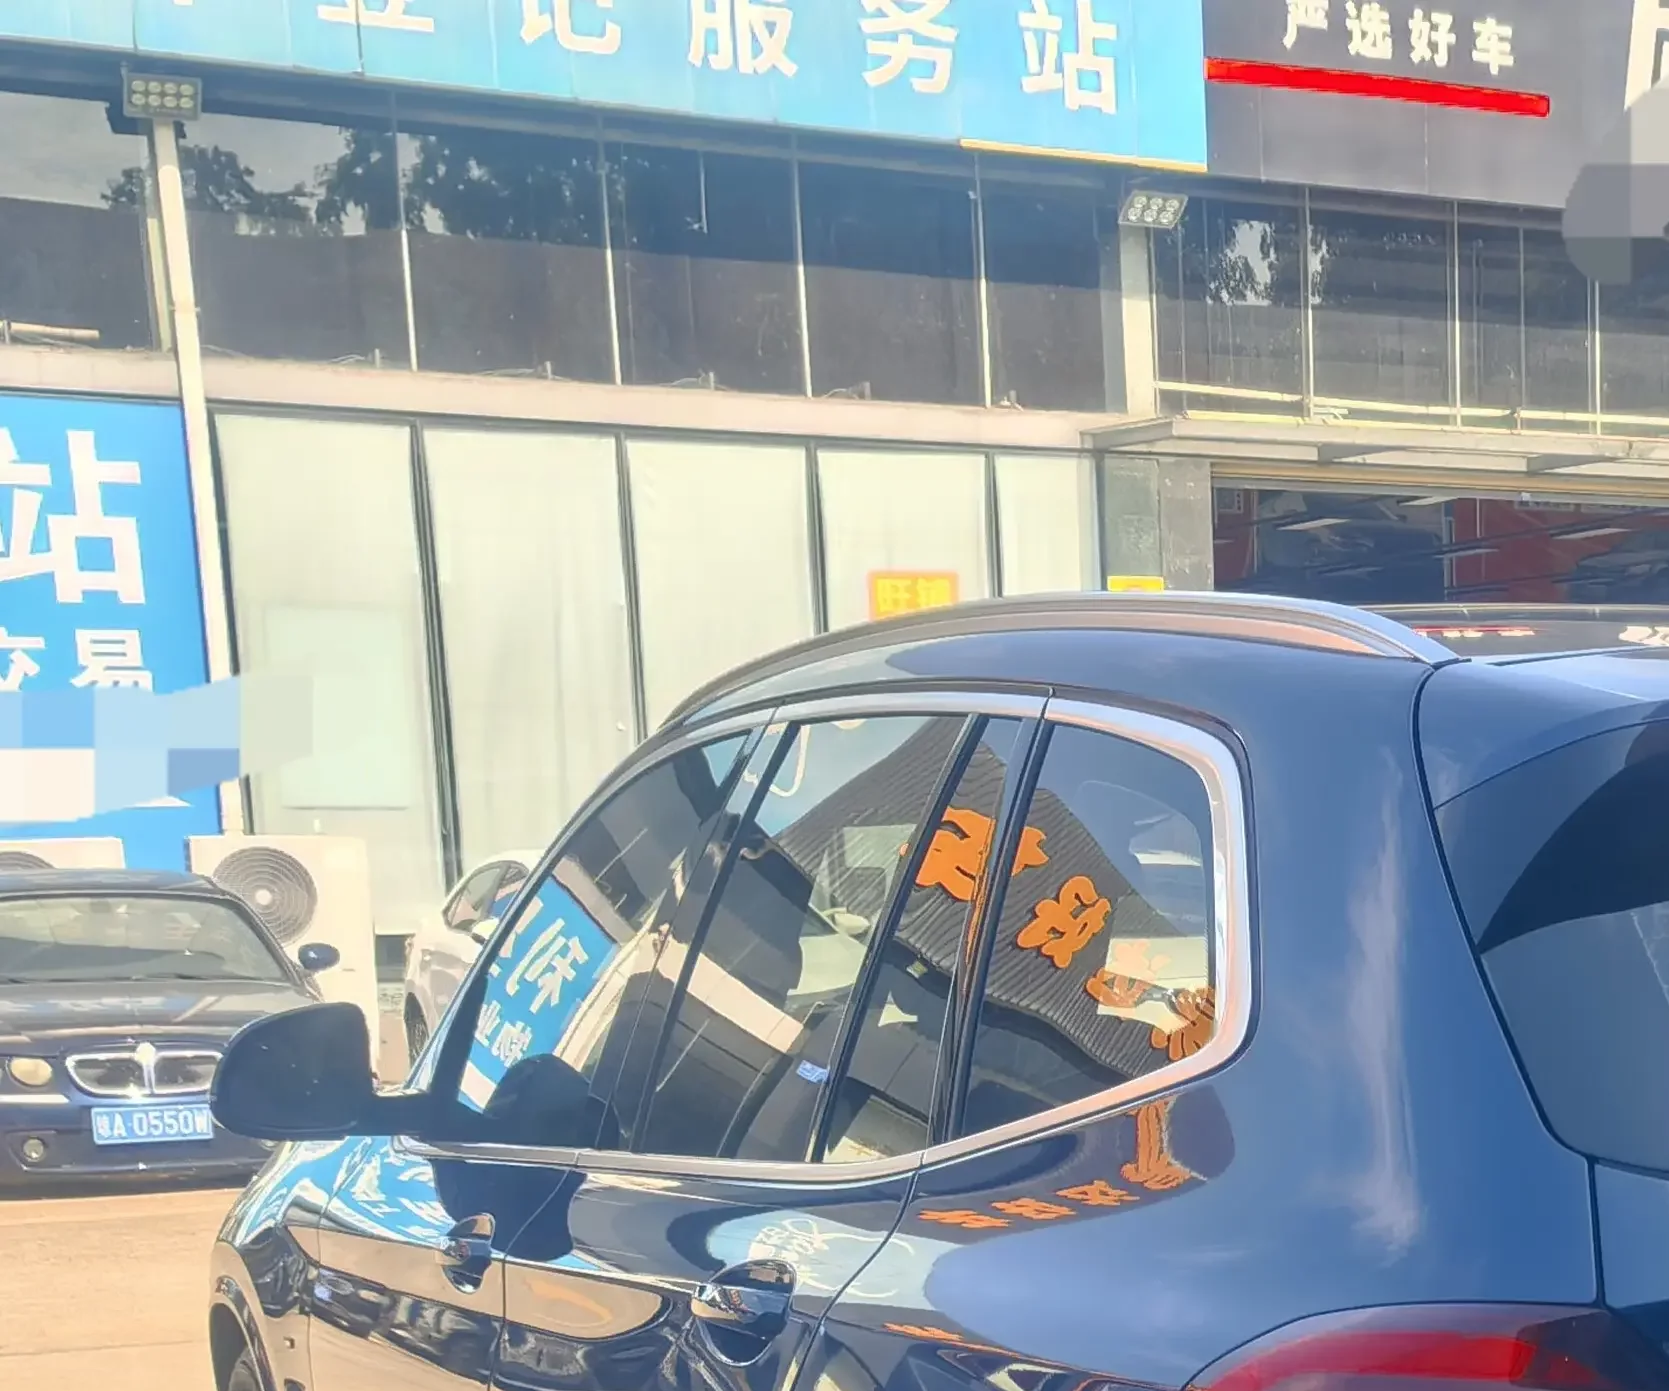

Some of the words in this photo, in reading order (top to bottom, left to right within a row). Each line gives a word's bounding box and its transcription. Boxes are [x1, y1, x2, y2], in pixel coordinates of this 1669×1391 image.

[1282, 0, 1514, 75] 严选好车
[0, 427, 146, 604] 站
